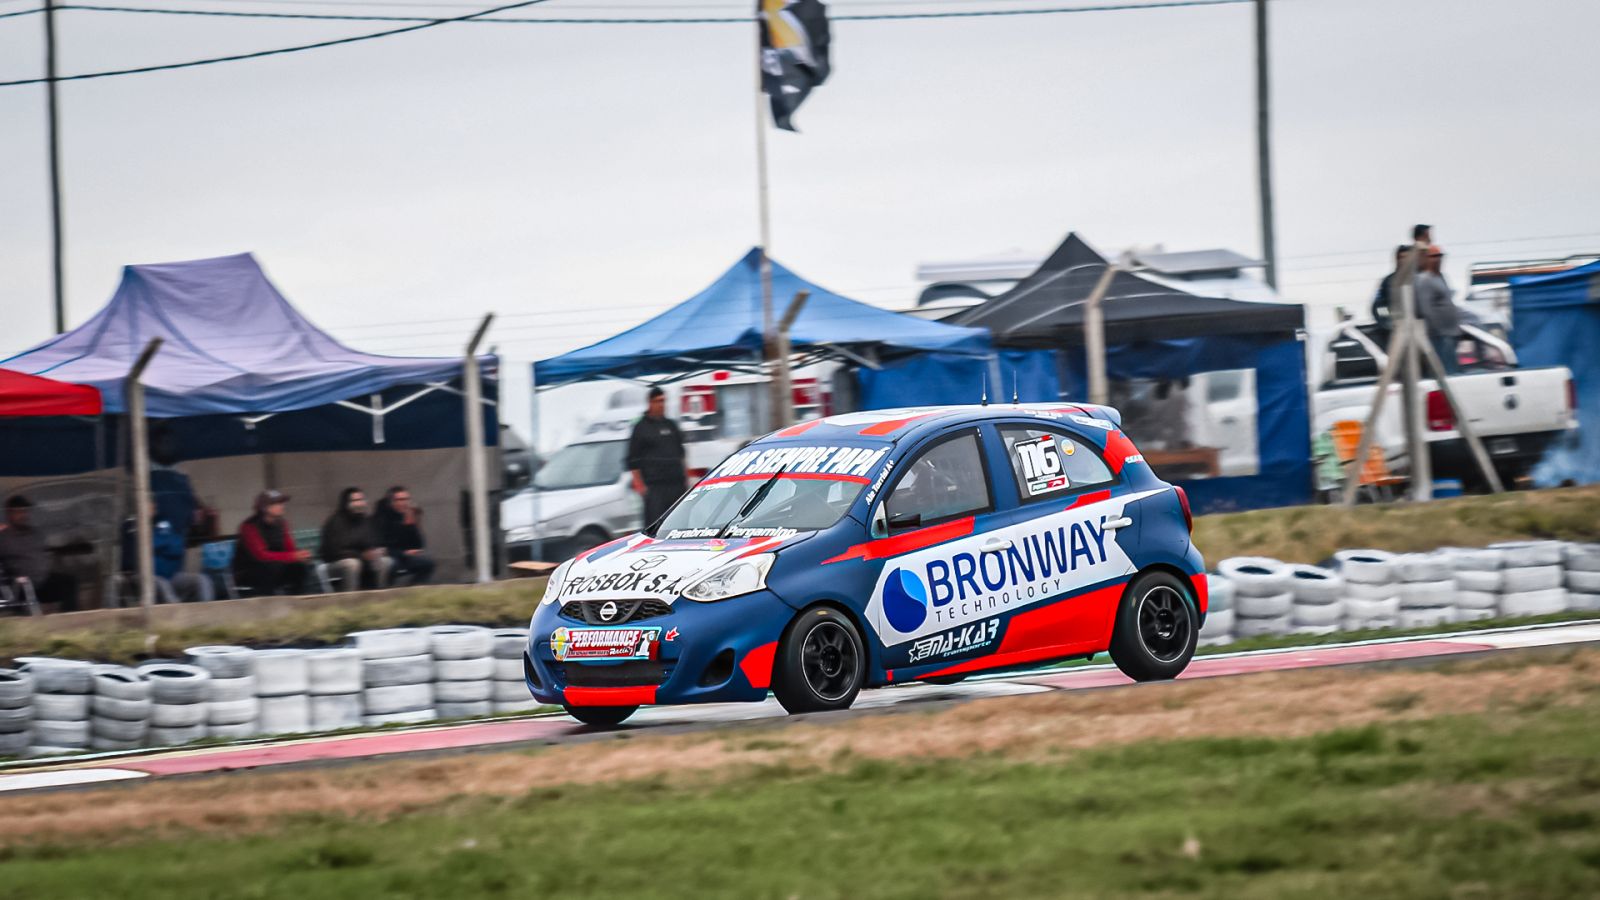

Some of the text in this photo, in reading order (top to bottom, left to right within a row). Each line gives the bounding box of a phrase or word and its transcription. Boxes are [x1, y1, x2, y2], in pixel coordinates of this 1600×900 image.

[711, 446, 890, 478] POR SIEMPRE PAPÁ
[666, 526, 797, 540] Parabrisa Pergamino
[926, 515, 1107, 607] BRONWAY
[562, 573, 681, 596] ROSBOX S.A.
[936, 578, 1061, 622] TECHNOLOGY
[570, 631, 641, 648] PERFORMANCE
